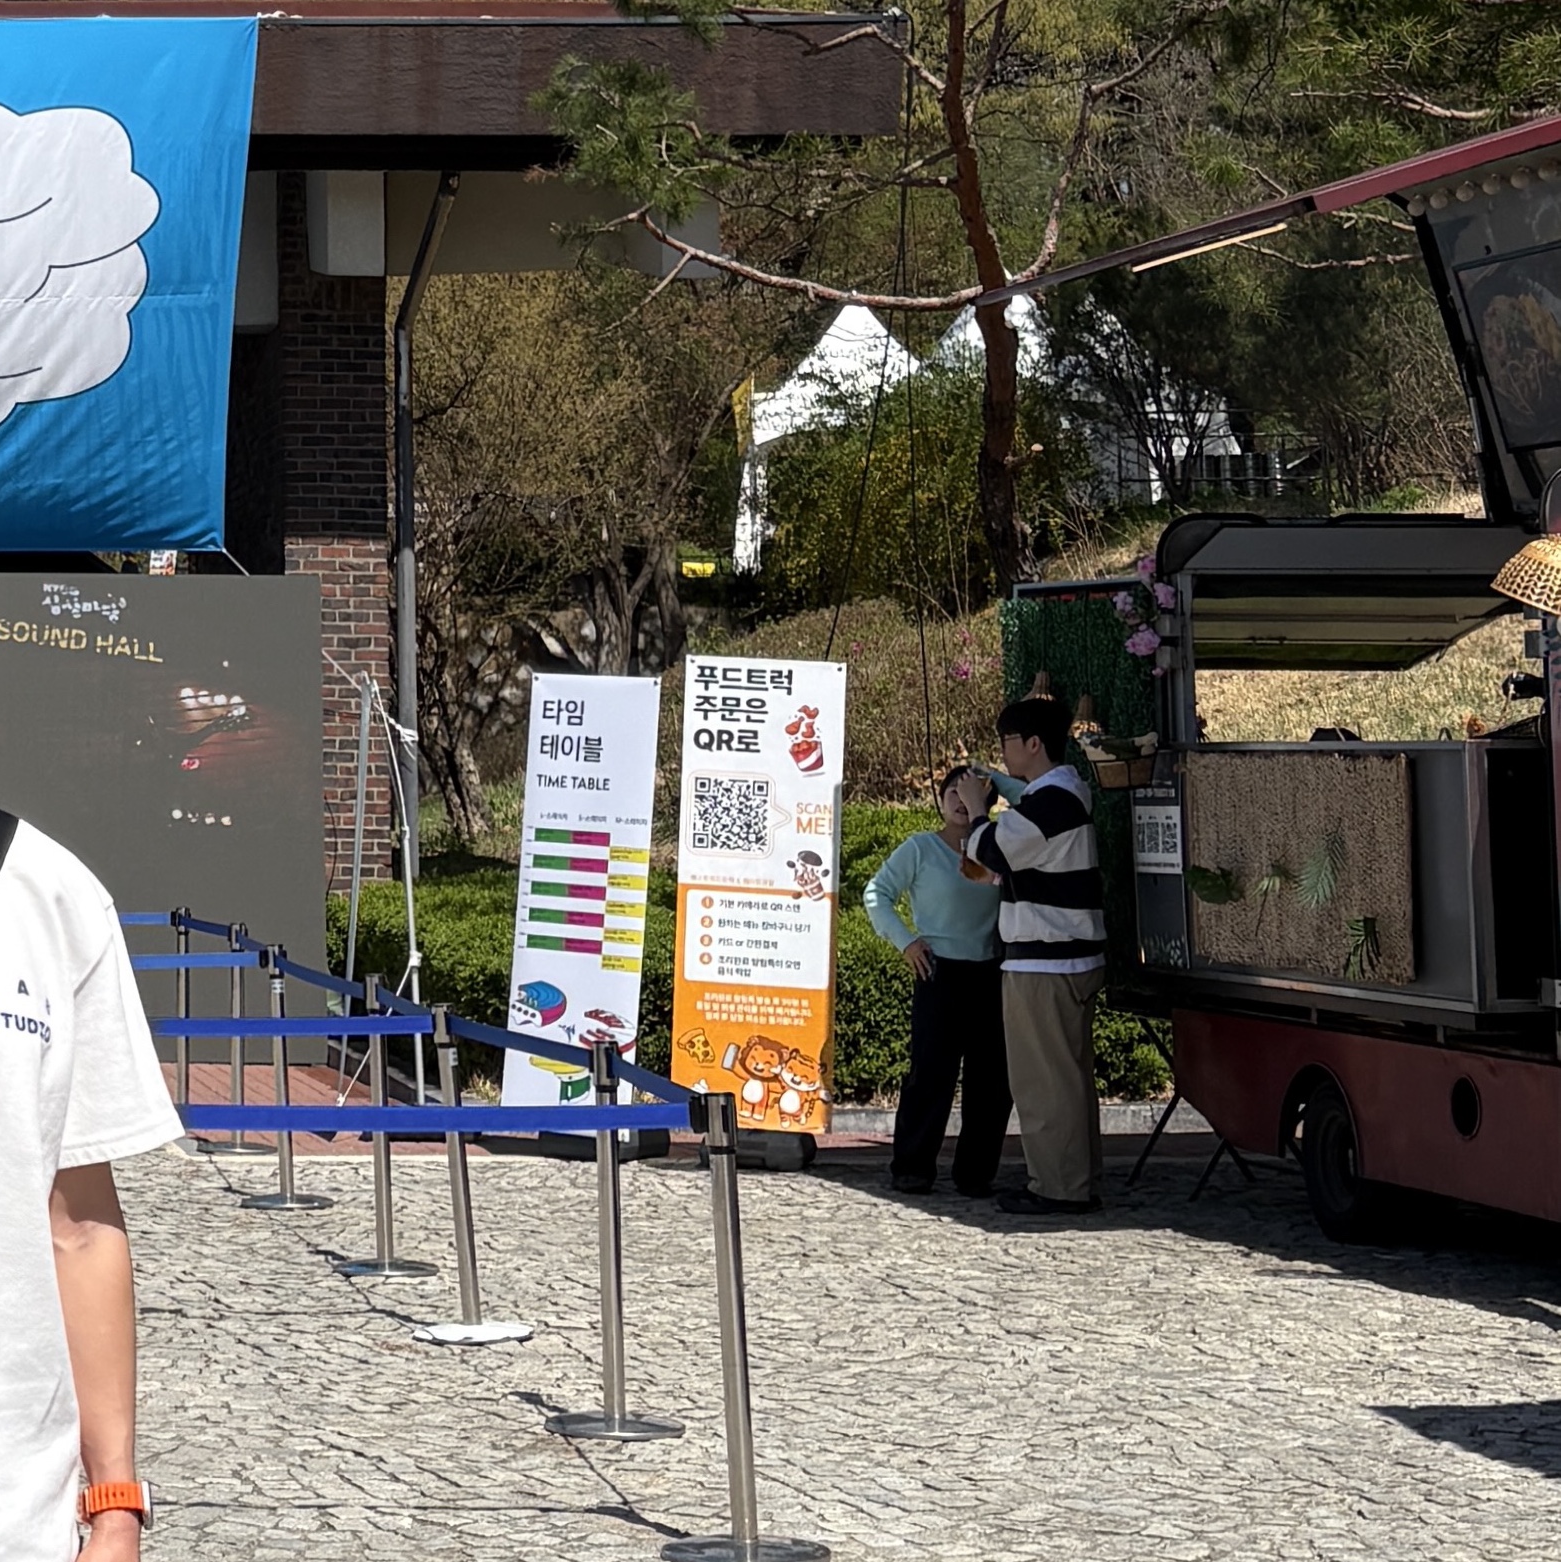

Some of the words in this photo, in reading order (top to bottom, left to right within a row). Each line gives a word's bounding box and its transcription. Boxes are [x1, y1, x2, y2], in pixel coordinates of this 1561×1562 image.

[96, 634, 164, 664] HALL
[694, 665, 793, 696] 푸드트럭
[542, 699, 585, 726] 타임
[693, 695, 769, 723] 주문은
[540, 734, 603, 763] 테이블
[693, 728, 761, 753] QR로
[537, 774, 568, 788] TIME
[571, 776, 611, 791] TABLE
[796, 802, 832, 815] SCAN
[796, 817, 833, 836] ME!
